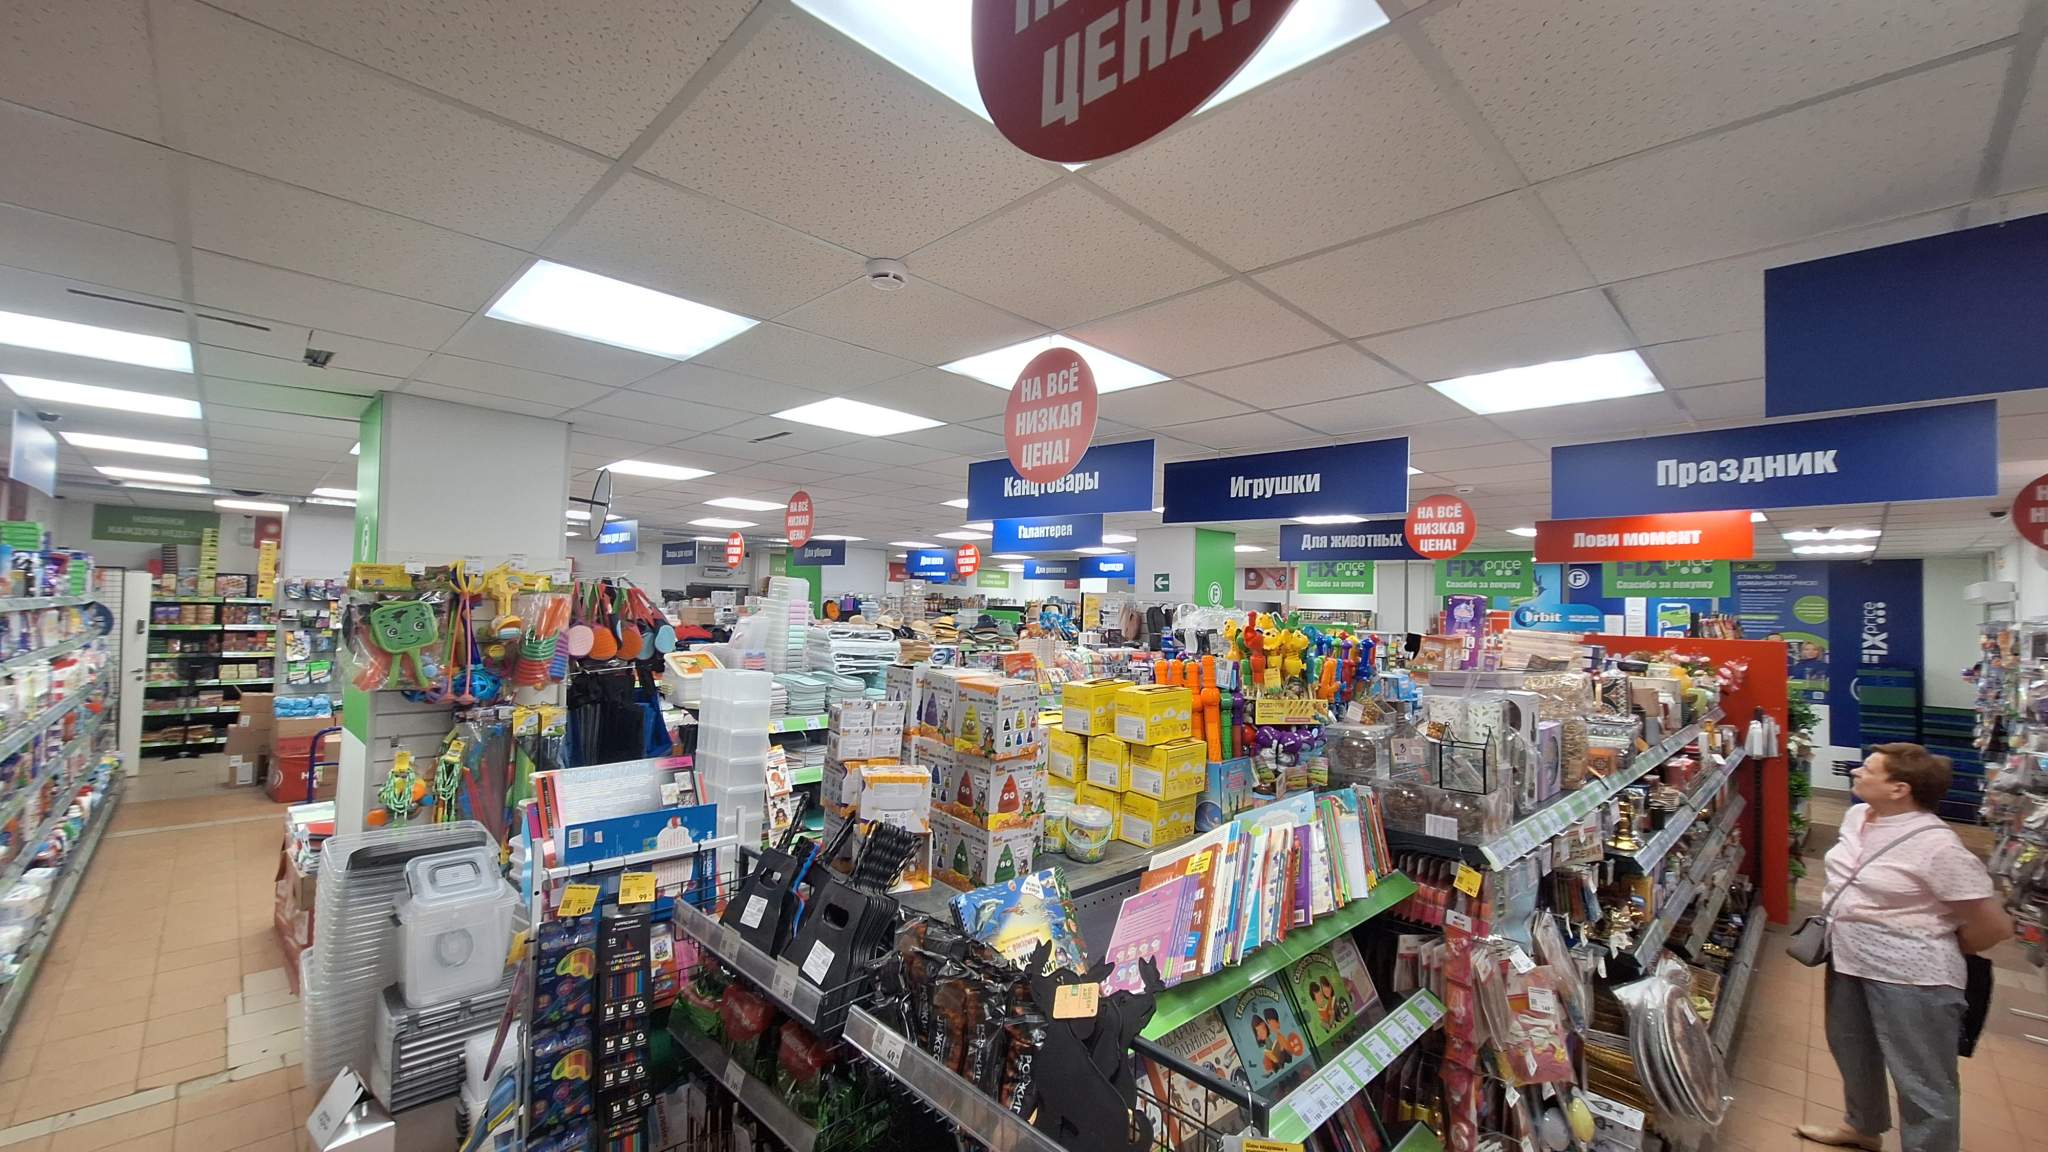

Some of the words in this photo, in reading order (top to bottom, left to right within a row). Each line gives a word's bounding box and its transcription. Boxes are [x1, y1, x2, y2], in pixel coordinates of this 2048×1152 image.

[1040, 0, 1251, 127] ЦЕНА
[1021, 376, 1041, 402] НА
[1047, 362, 1079, 397] ВСЁ
[1016, 401, 1082, 437] НИЗКАЯ
[1022, 438, 1070, 470] ЦЕНА!
[1657, 450, 1838, 488] Праздник
[1230, 473, 1320, 498] Игрушки
[790, 503, 799, 513] НА
[1417, 507, 1433, 519] НА
[1437, 503, 1462, 518] ВСЁ
[788, 516, 809, 527] НИЗКАЯ
[1414, 522, 1465, 535] НИЗКАЯ
[1018, 524, 1072, 539] Галантерея
[1573, 531, 1619, 548] Лови
[1622, 529, 1702, 547] момент
[1301, 534, 1327, 550] Для
[1331, 533, 1403, 549] животных
[1420, 539, 1457, 553] ЦЕНА!
[1307, 561, 1337, 577] FIX
[1336, 561, 1365, 575] price
[1446, 560, 1485, 577] FIX
[1485, 559, 1522, 573] price
[1617, 560, 1666, 577] FIX
[1446, 581, 1478, 589] Спасибо
[1616, 580, 1657, 589] Спасибо
[1675, 581, 1714, 590] покупку
[1515, 606, 1561, 627] Orbit
[1864, 601, 1881, 633] price
